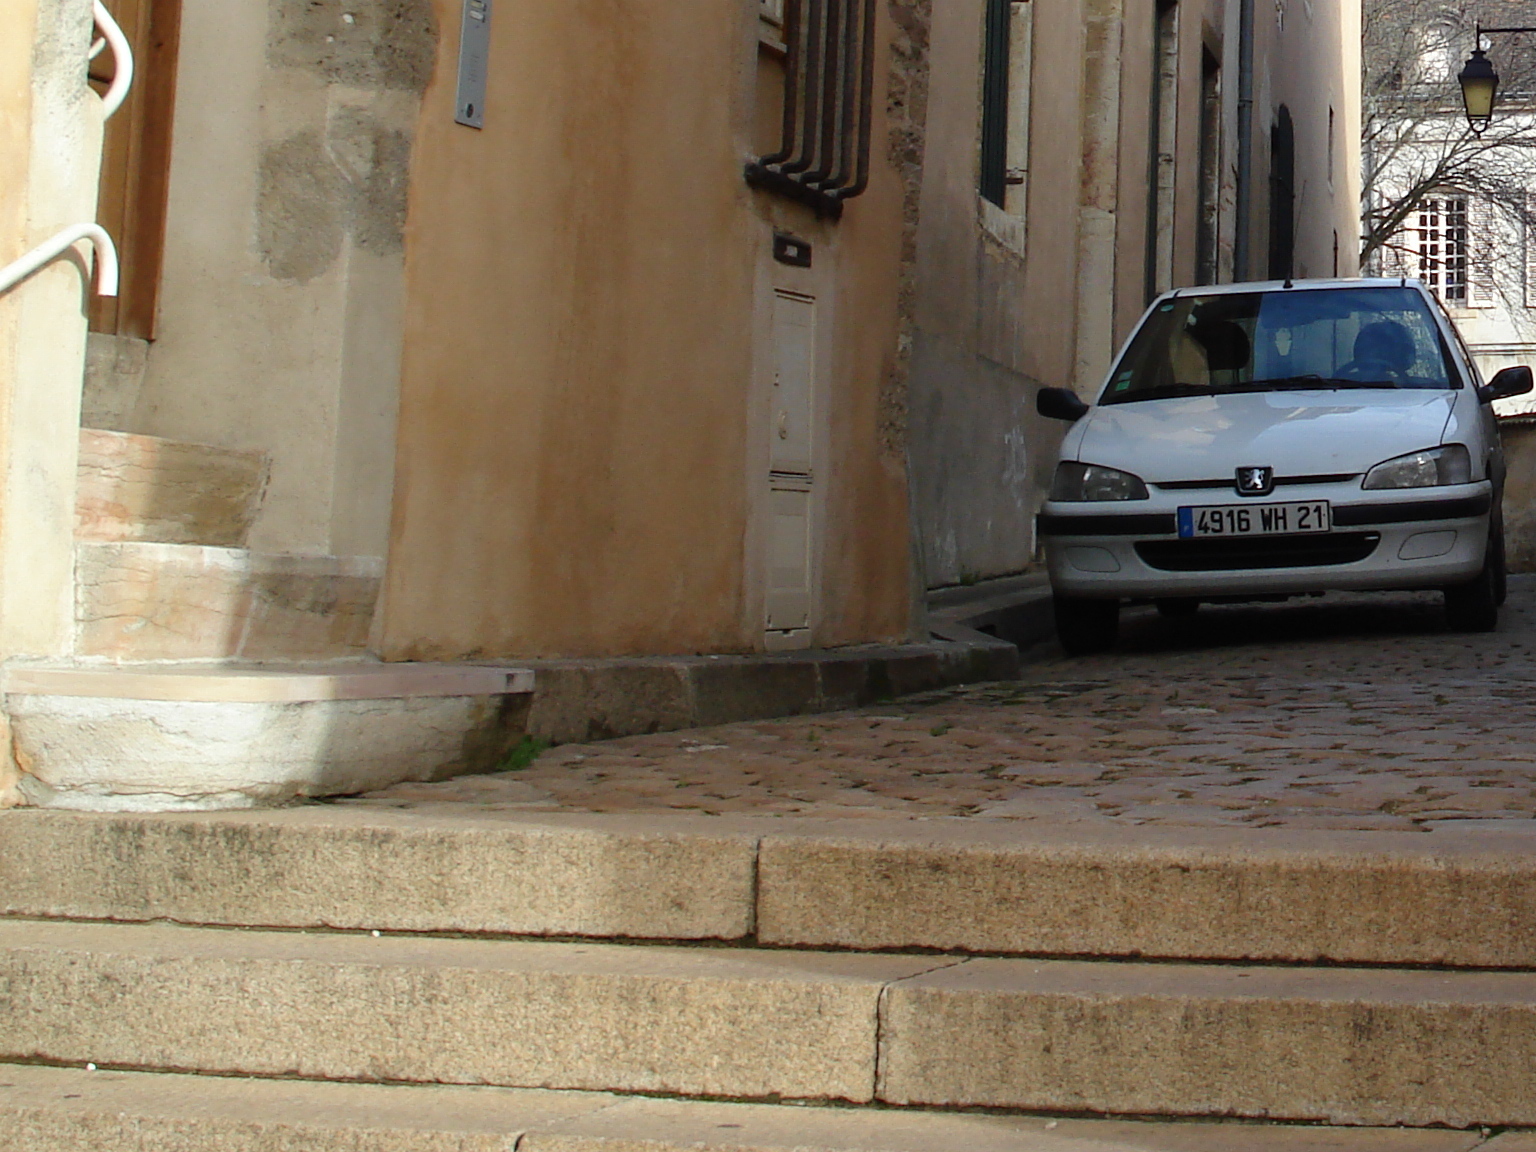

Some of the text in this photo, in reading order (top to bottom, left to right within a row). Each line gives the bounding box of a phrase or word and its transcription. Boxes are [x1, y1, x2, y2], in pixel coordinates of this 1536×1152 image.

[1197, 509, 1250, 534] 4916
[1260, 507, 1287, 531] WH
[1297, 505, 1322, 529] 21
